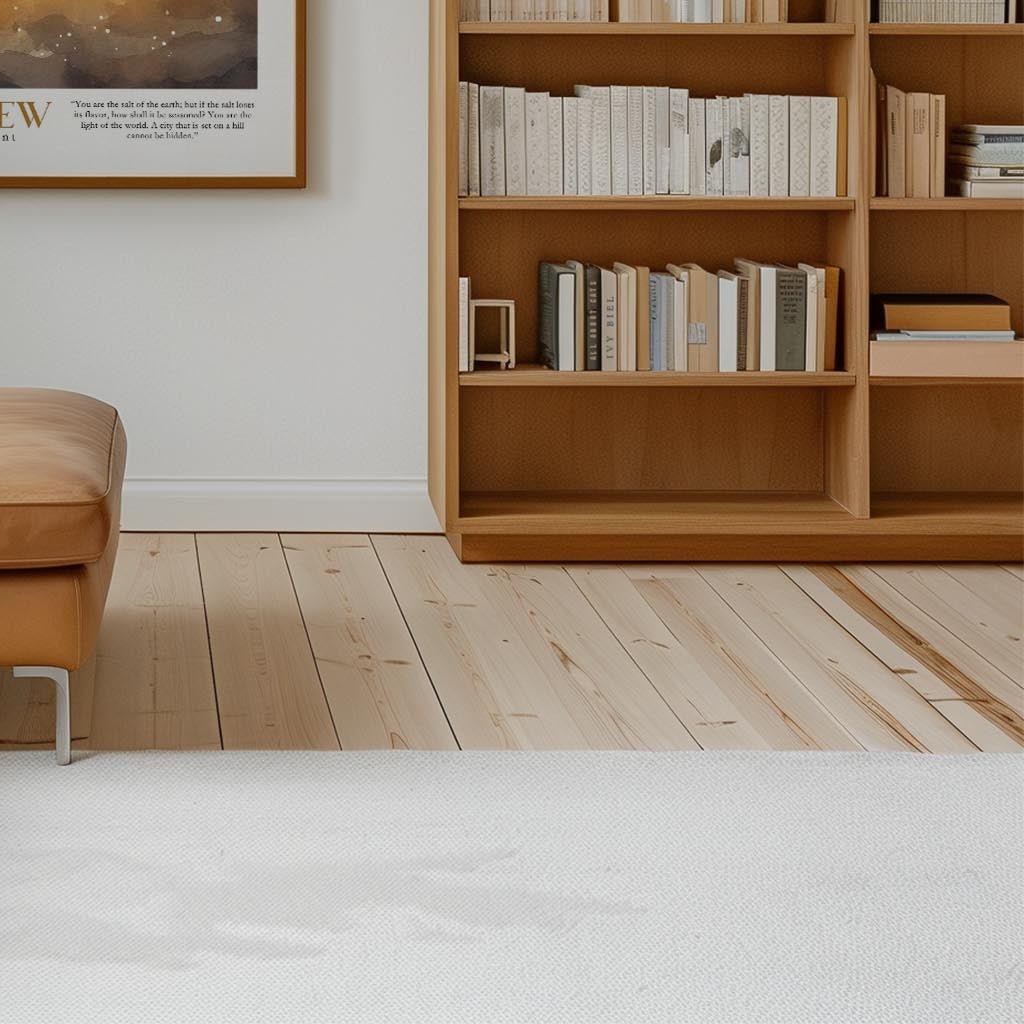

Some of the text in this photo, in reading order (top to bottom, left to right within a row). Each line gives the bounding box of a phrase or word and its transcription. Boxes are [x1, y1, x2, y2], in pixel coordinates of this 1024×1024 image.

[93, 100, 105, 108] are
[106, 100, 118, 108] the
[121, 100, 134, 108] salt
[136, 100, 145, 108] of
[146, 100, 159, 108] the
[184, 100, 197, 108] but
[199, 100, 205, 108] if
[208, 100, 219, 108] the
[221, 100, 234, 108] salt
[208, 110, 224, 118] You
[81, 122, 98, 130] light
[159, 122, 173, 130] city
[589, 281, 598, 361] ALL ABOUT CATS
[606, 296, 614, 359] IVY BIEL
